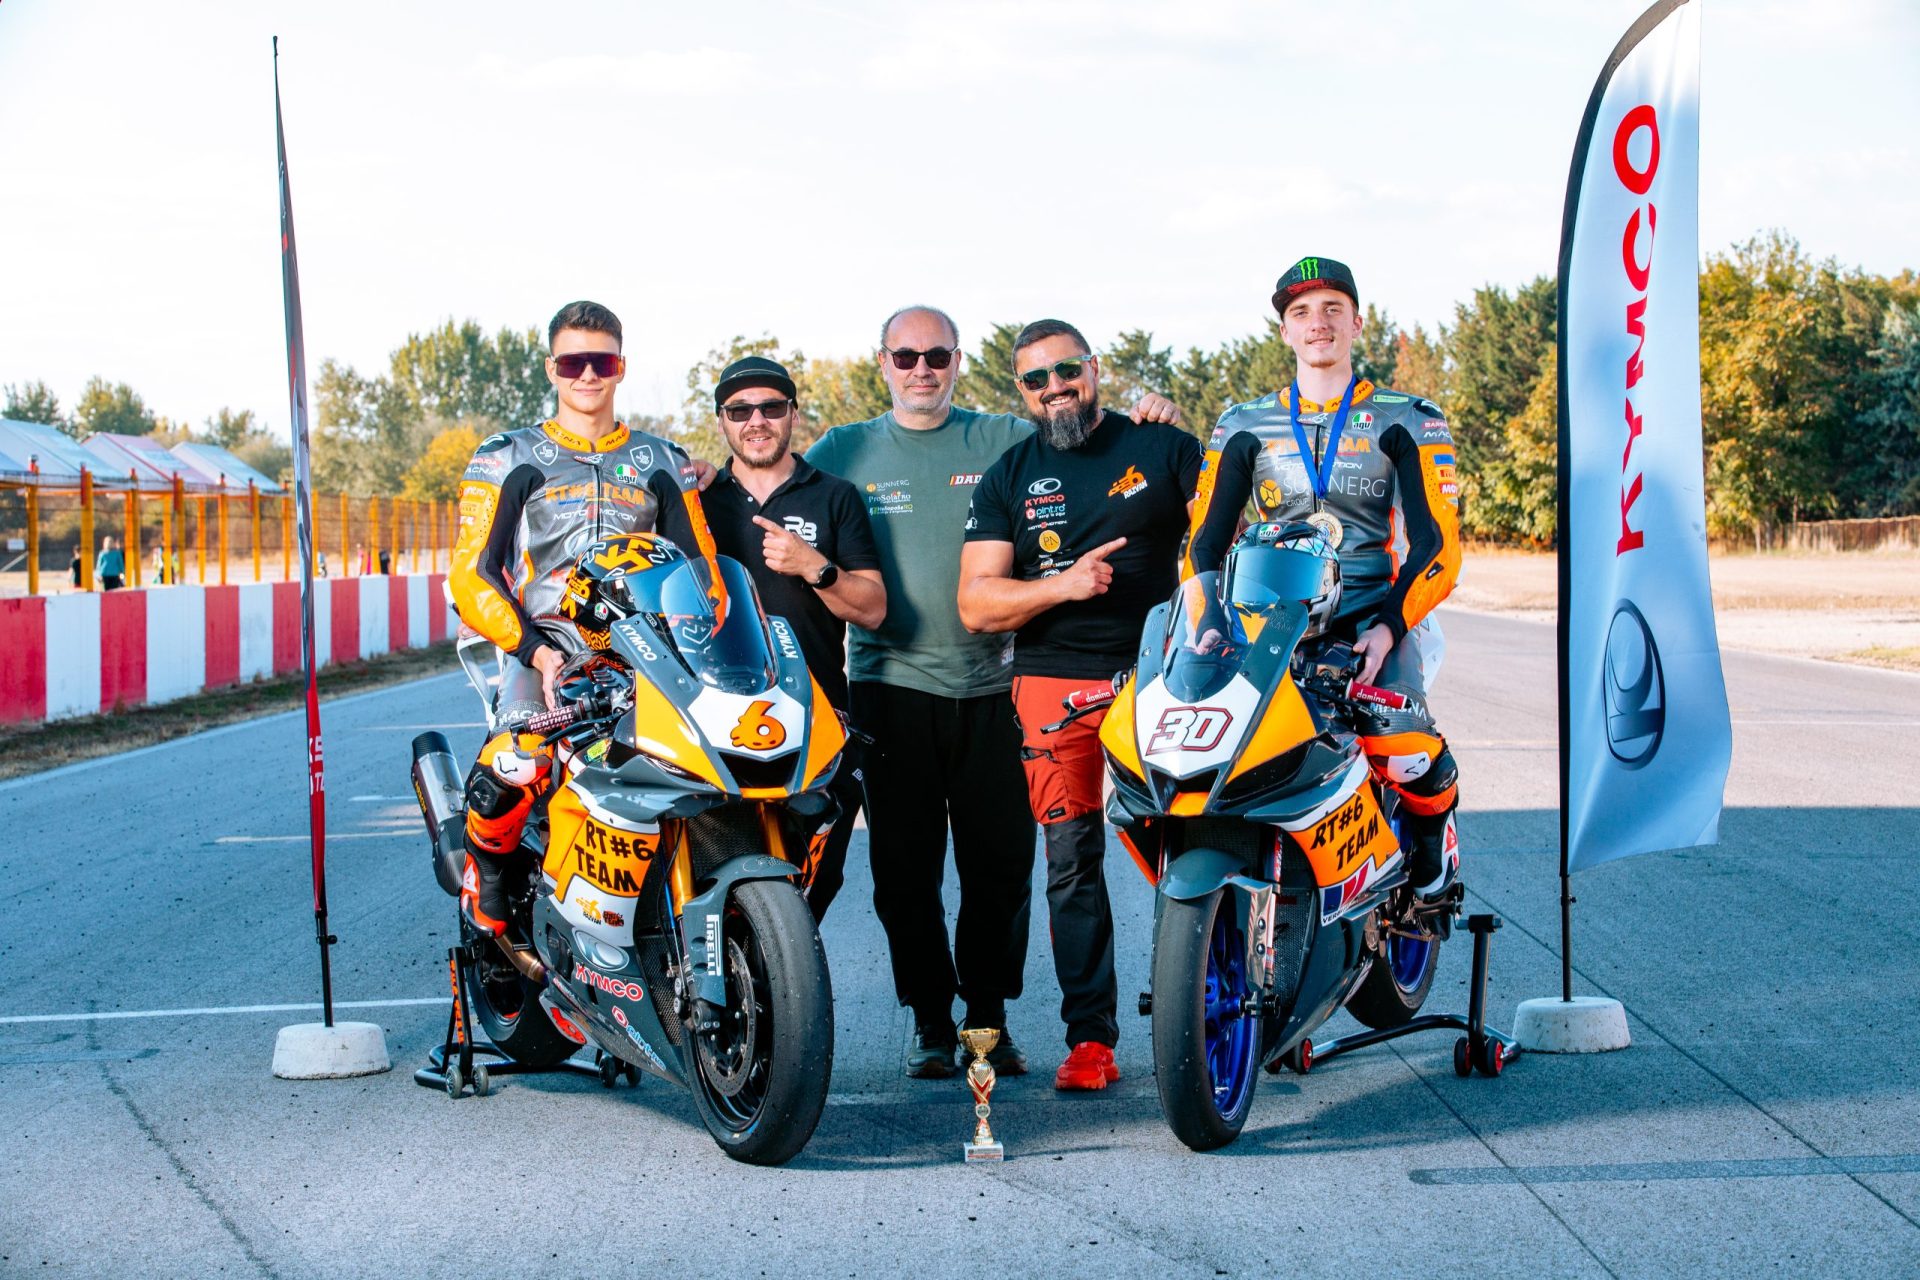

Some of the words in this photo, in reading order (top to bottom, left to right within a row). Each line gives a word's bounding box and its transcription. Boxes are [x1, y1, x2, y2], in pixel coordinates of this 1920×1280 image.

[1353, 422, 1371, 431] agv
[603, 482, 646, 506] TEAM
[1025, 494, 1065, 507] KYMCO
[1123, 479, 1148, 499] RAZVAN
[553, 509, 588, 521] MOTO
[782, 515, 817, 542] RB
[618, 623, 658, 662] KYMCO
[771, 620, 799, 659] KYMCO
[1085, 689, 1112, 703] domina
[1356, 689, 1387, 704] domina
[528, 705, 574, 725] RENTHAL
[530, 713, 576, 732] RENTHAL
[729, 699, 787, 751] 6
[1145, 705, 1233, 757] 30
[1310, 794, 1364, 850] RT#6
[1336, 812, 1379, 872] TEAM
[574, 843, 641, 893] TEAM
[706, 914, 721, 977] PIRELLI
[575, 961, 644, 1002] KYMCO
